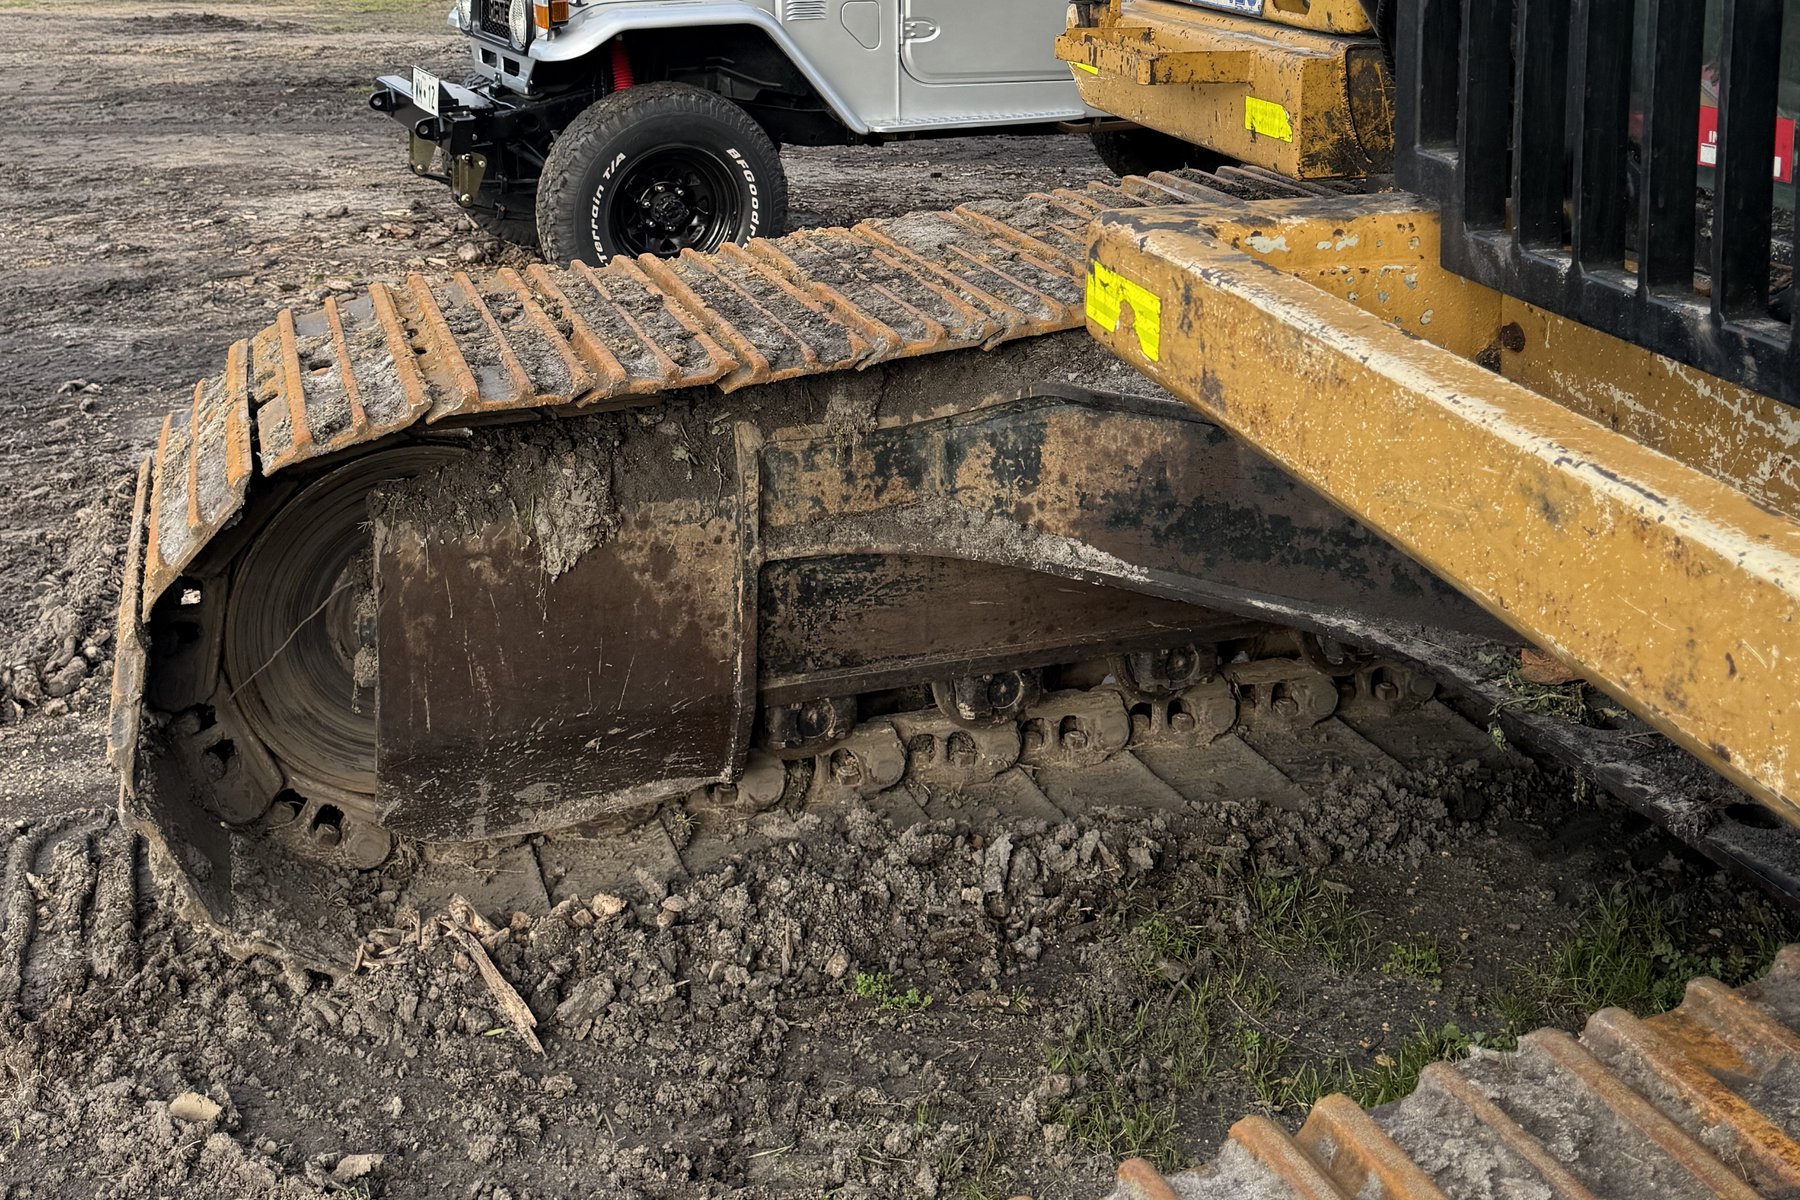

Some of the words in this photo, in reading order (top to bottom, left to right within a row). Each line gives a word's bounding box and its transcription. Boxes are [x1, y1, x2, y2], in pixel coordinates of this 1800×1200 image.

[591, 185, 608, 264] Terrain
[602, 152, 627, 180] T/A
[726, 148, 760, 250] BFGoodr
